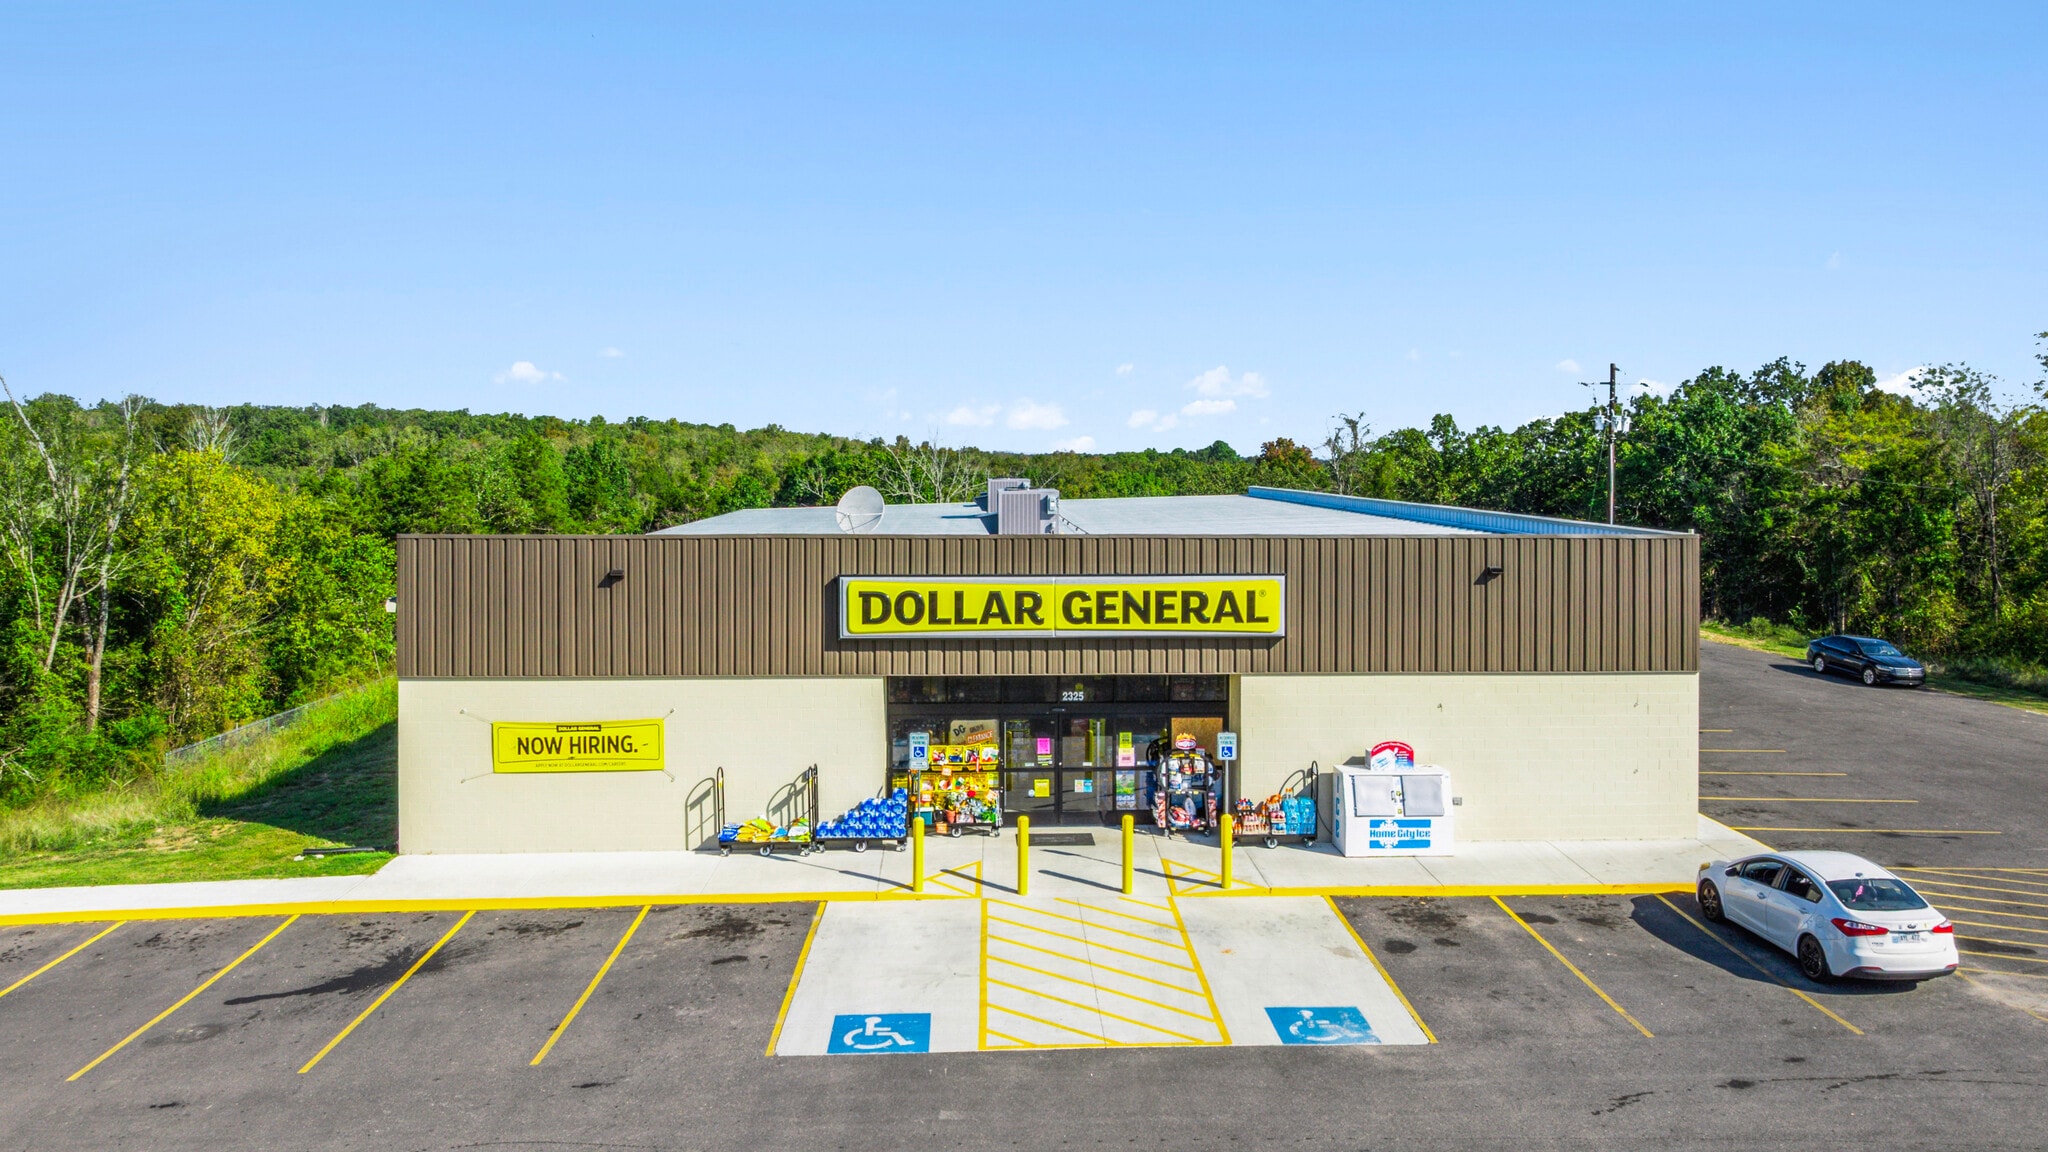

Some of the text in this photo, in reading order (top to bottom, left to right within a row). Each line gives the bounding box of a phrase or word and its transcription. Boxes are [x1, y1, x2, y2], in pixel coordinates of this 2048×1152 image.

[858, 589, 1269, 626] DOLLAR GENERAL
[1062, 691, 1084, 701] 2325
[953, 724, 966, 737] DG
[517, 735, 638, 755] NOW HIRING.
[1369, 829, 1431, 839] Home City Ice
